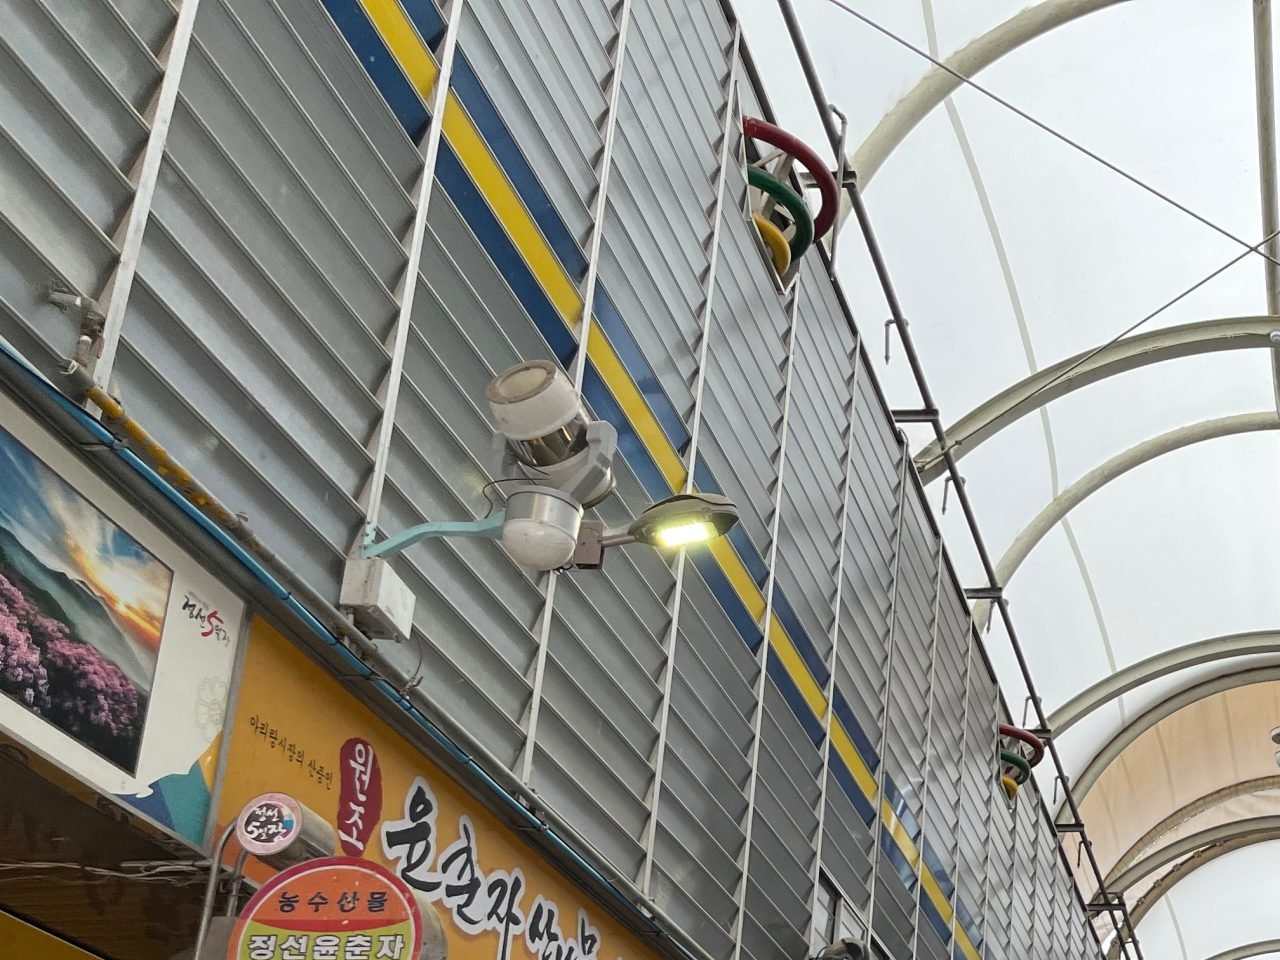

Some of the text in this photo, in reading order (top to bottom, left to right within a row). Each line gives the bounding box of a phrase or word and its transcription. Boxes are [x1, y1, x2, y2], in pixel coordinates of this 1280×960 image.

[250, 714, 304, 767] 아리랑시장의
[338, 741, 373, 851] 원조
[278, 891, 388, 913] 농수산물
[248, 934, 405, 960] 정선윤춘자
